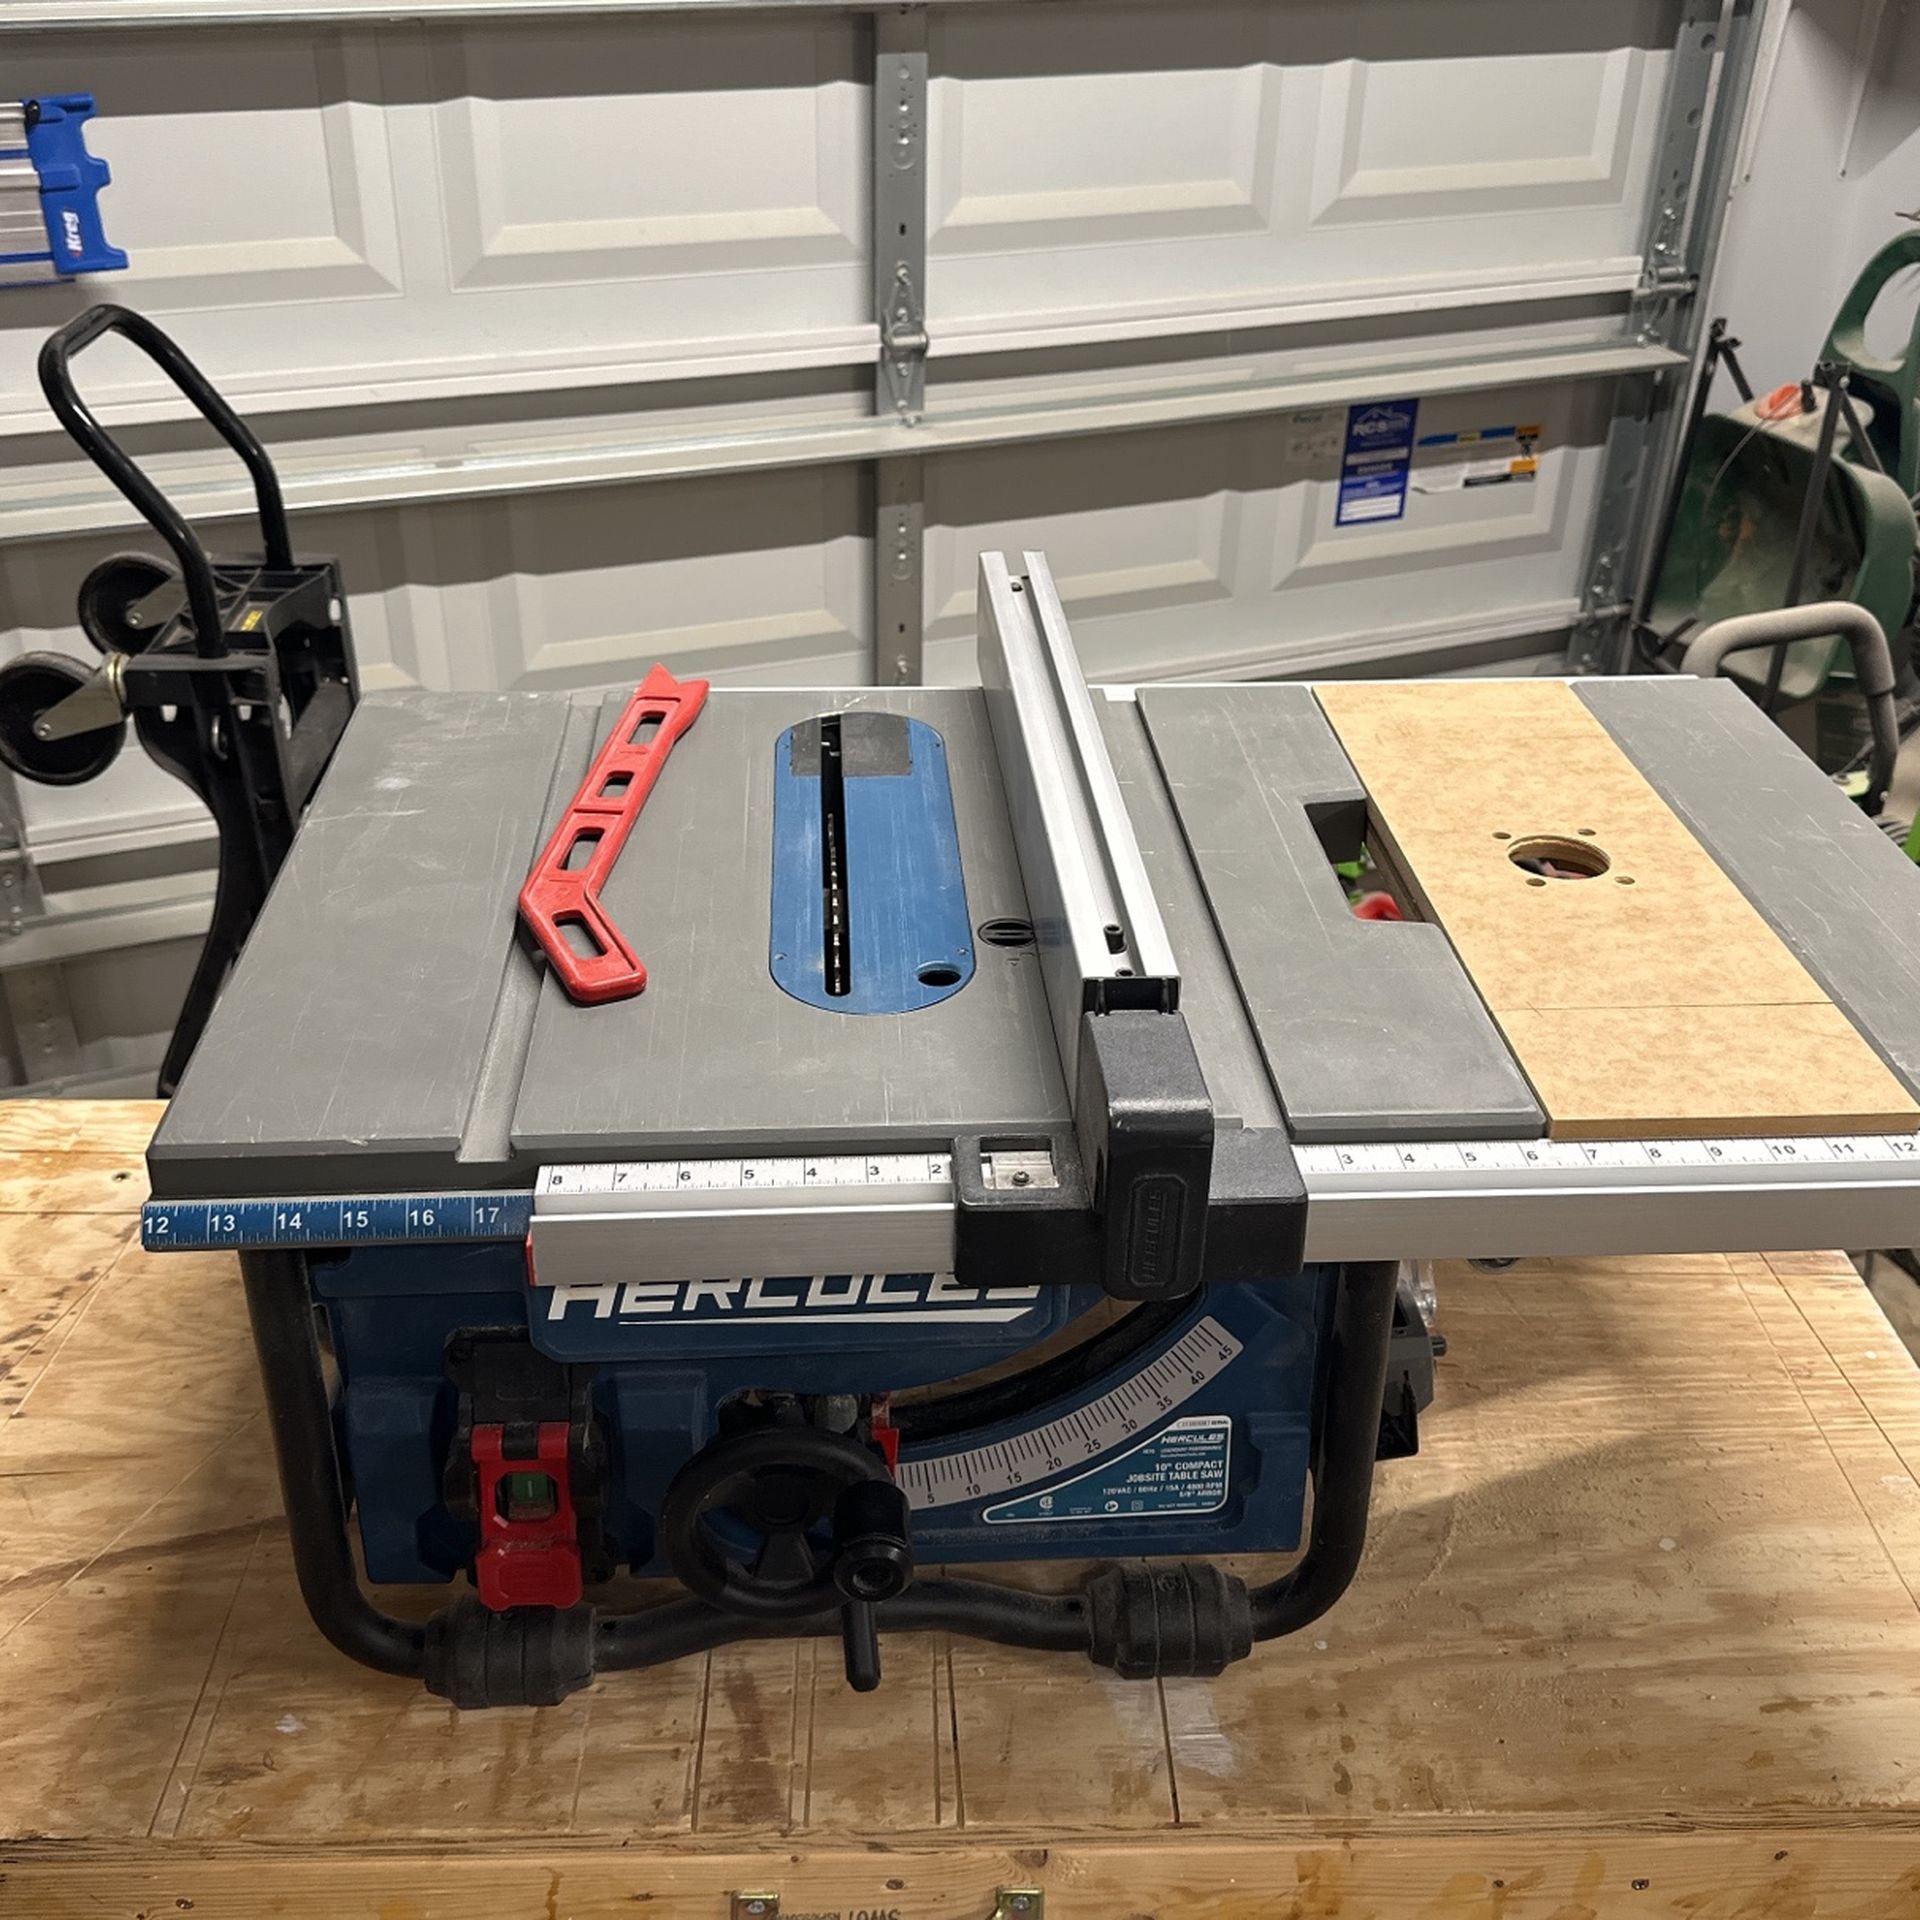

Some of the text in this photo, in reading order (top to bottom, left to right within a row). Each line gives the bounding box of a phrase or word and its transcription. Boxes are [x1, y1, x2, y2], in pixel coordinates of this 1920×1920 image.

[1342, 1142, 1917, 1165] 3 4 5 6 7 8 9 10 11 12
[551, 1164, 942, 1186] 8 7 6 5 4 3 2
[144, 1207, 500, 1235] 12 13 14 15 16 17
[927, 1345, 1233, 1504] 5 10 15 20 25 30 35 40 45
[1160, 1433, 1225, 1445] HERCULES
[1126, 1469, 1224, 1483] JOBSITE TABLE SAW
[1174, 1460, 1224, 1471] COMPACT
